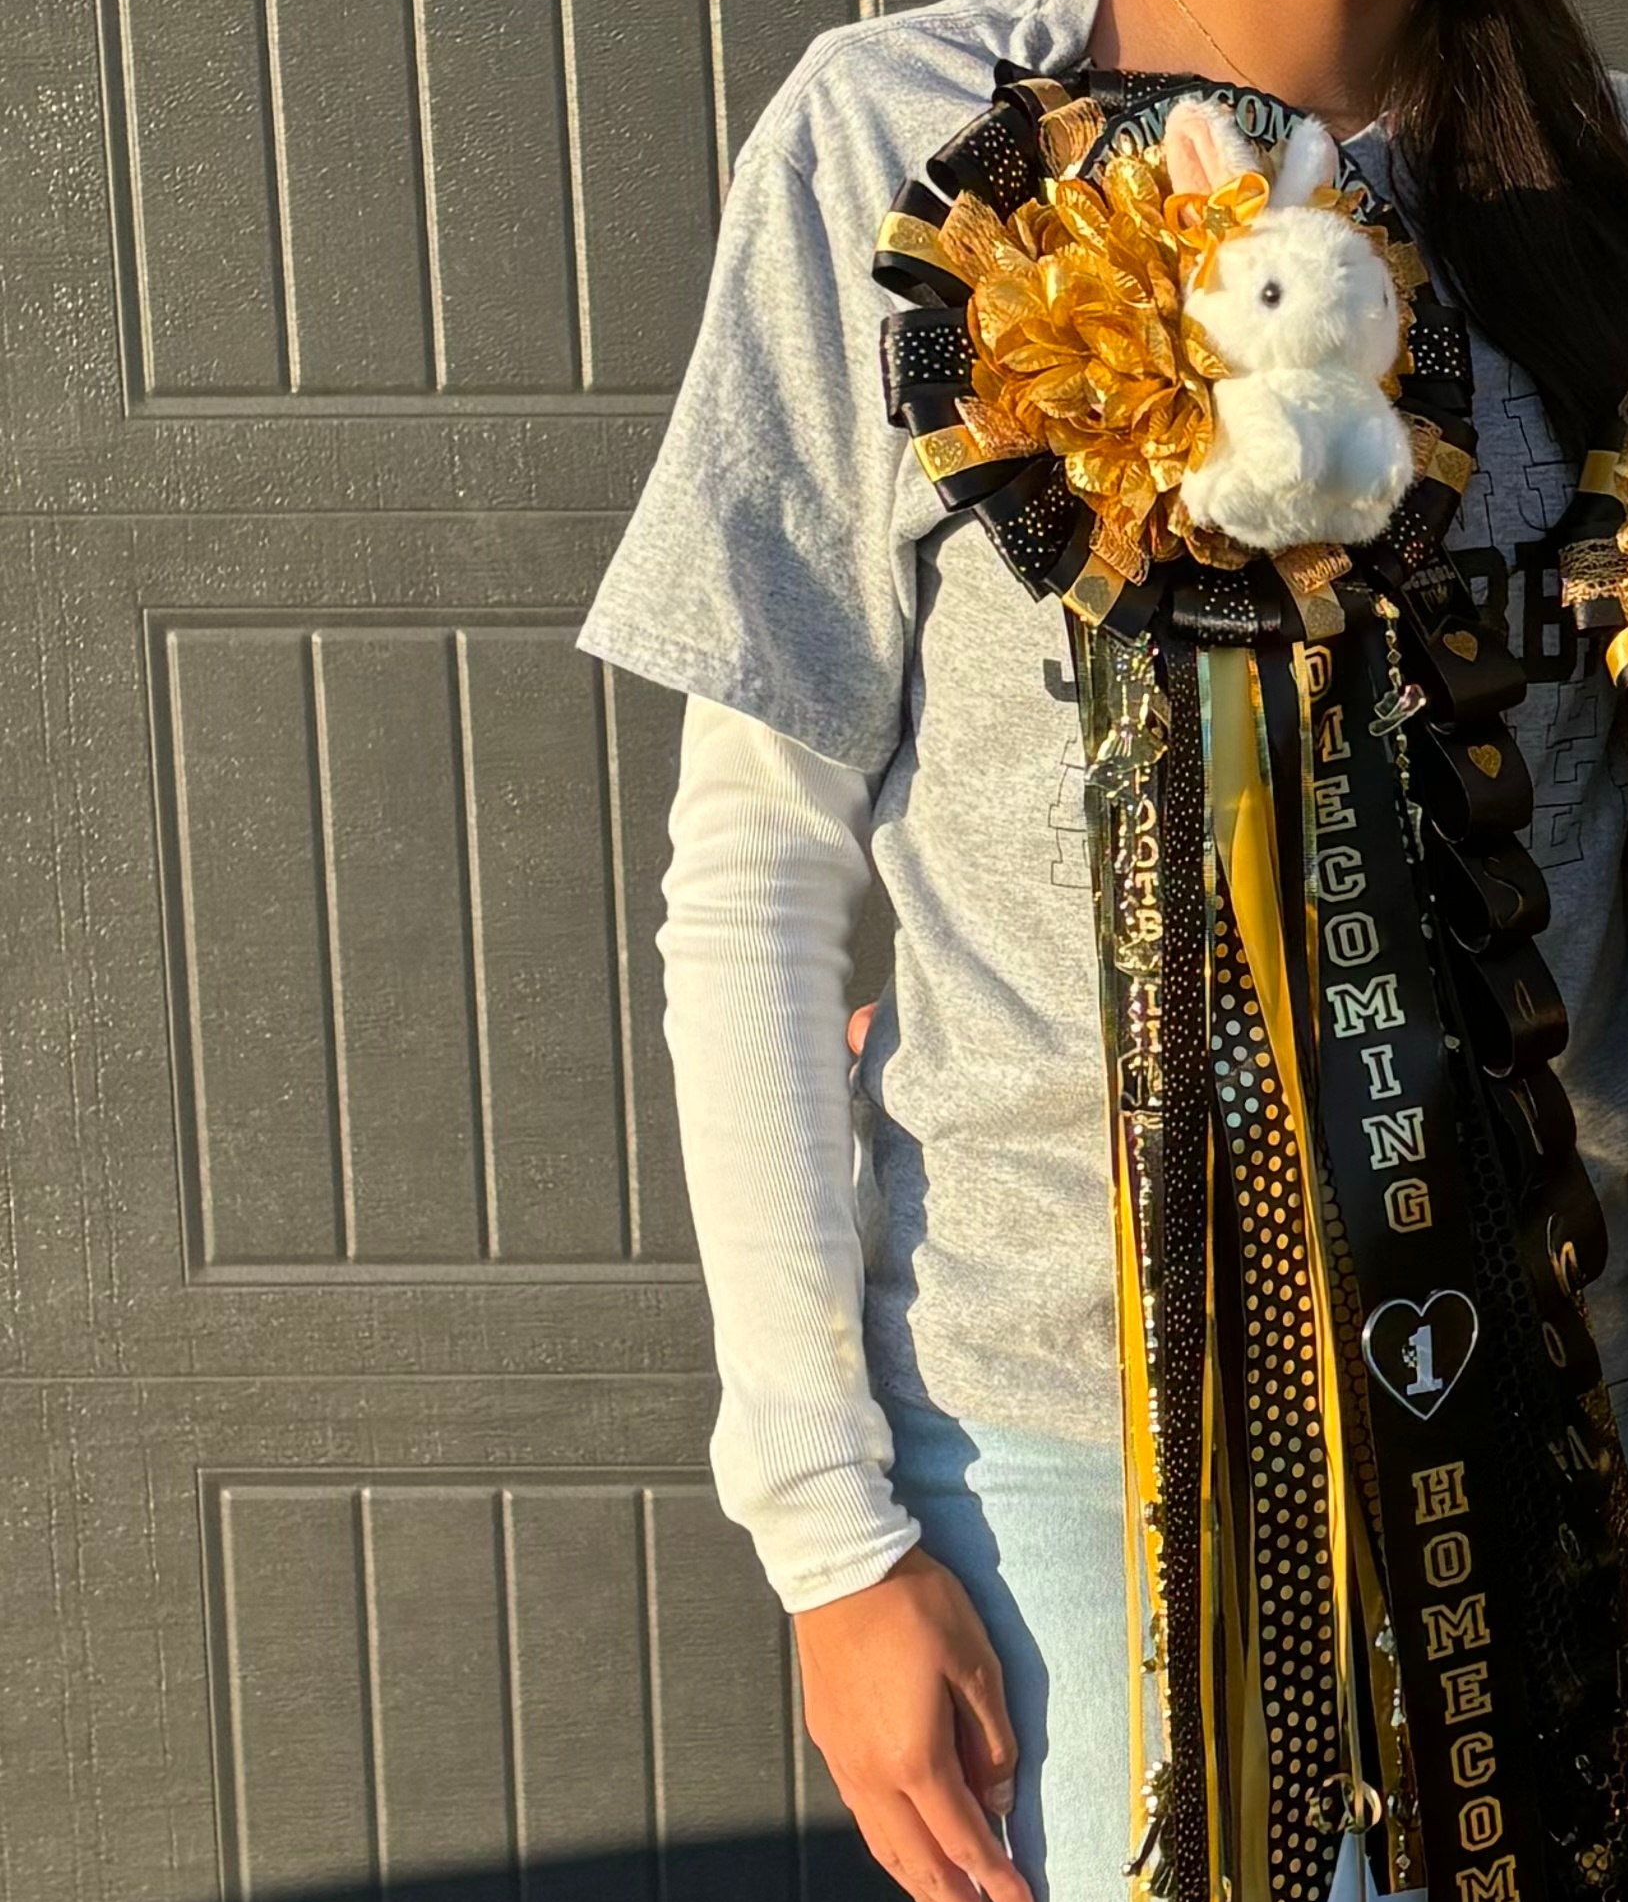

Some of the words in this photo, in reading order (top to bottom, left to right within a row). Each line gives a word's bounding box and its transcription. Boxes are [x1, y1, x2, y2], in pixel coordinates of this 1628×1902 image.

[1133, 766, 1165, 1054] FOOTBLL
[1288, 643, 1433, 1234] OMECOMING
[1406, 1324, 1444, 1396] 1
